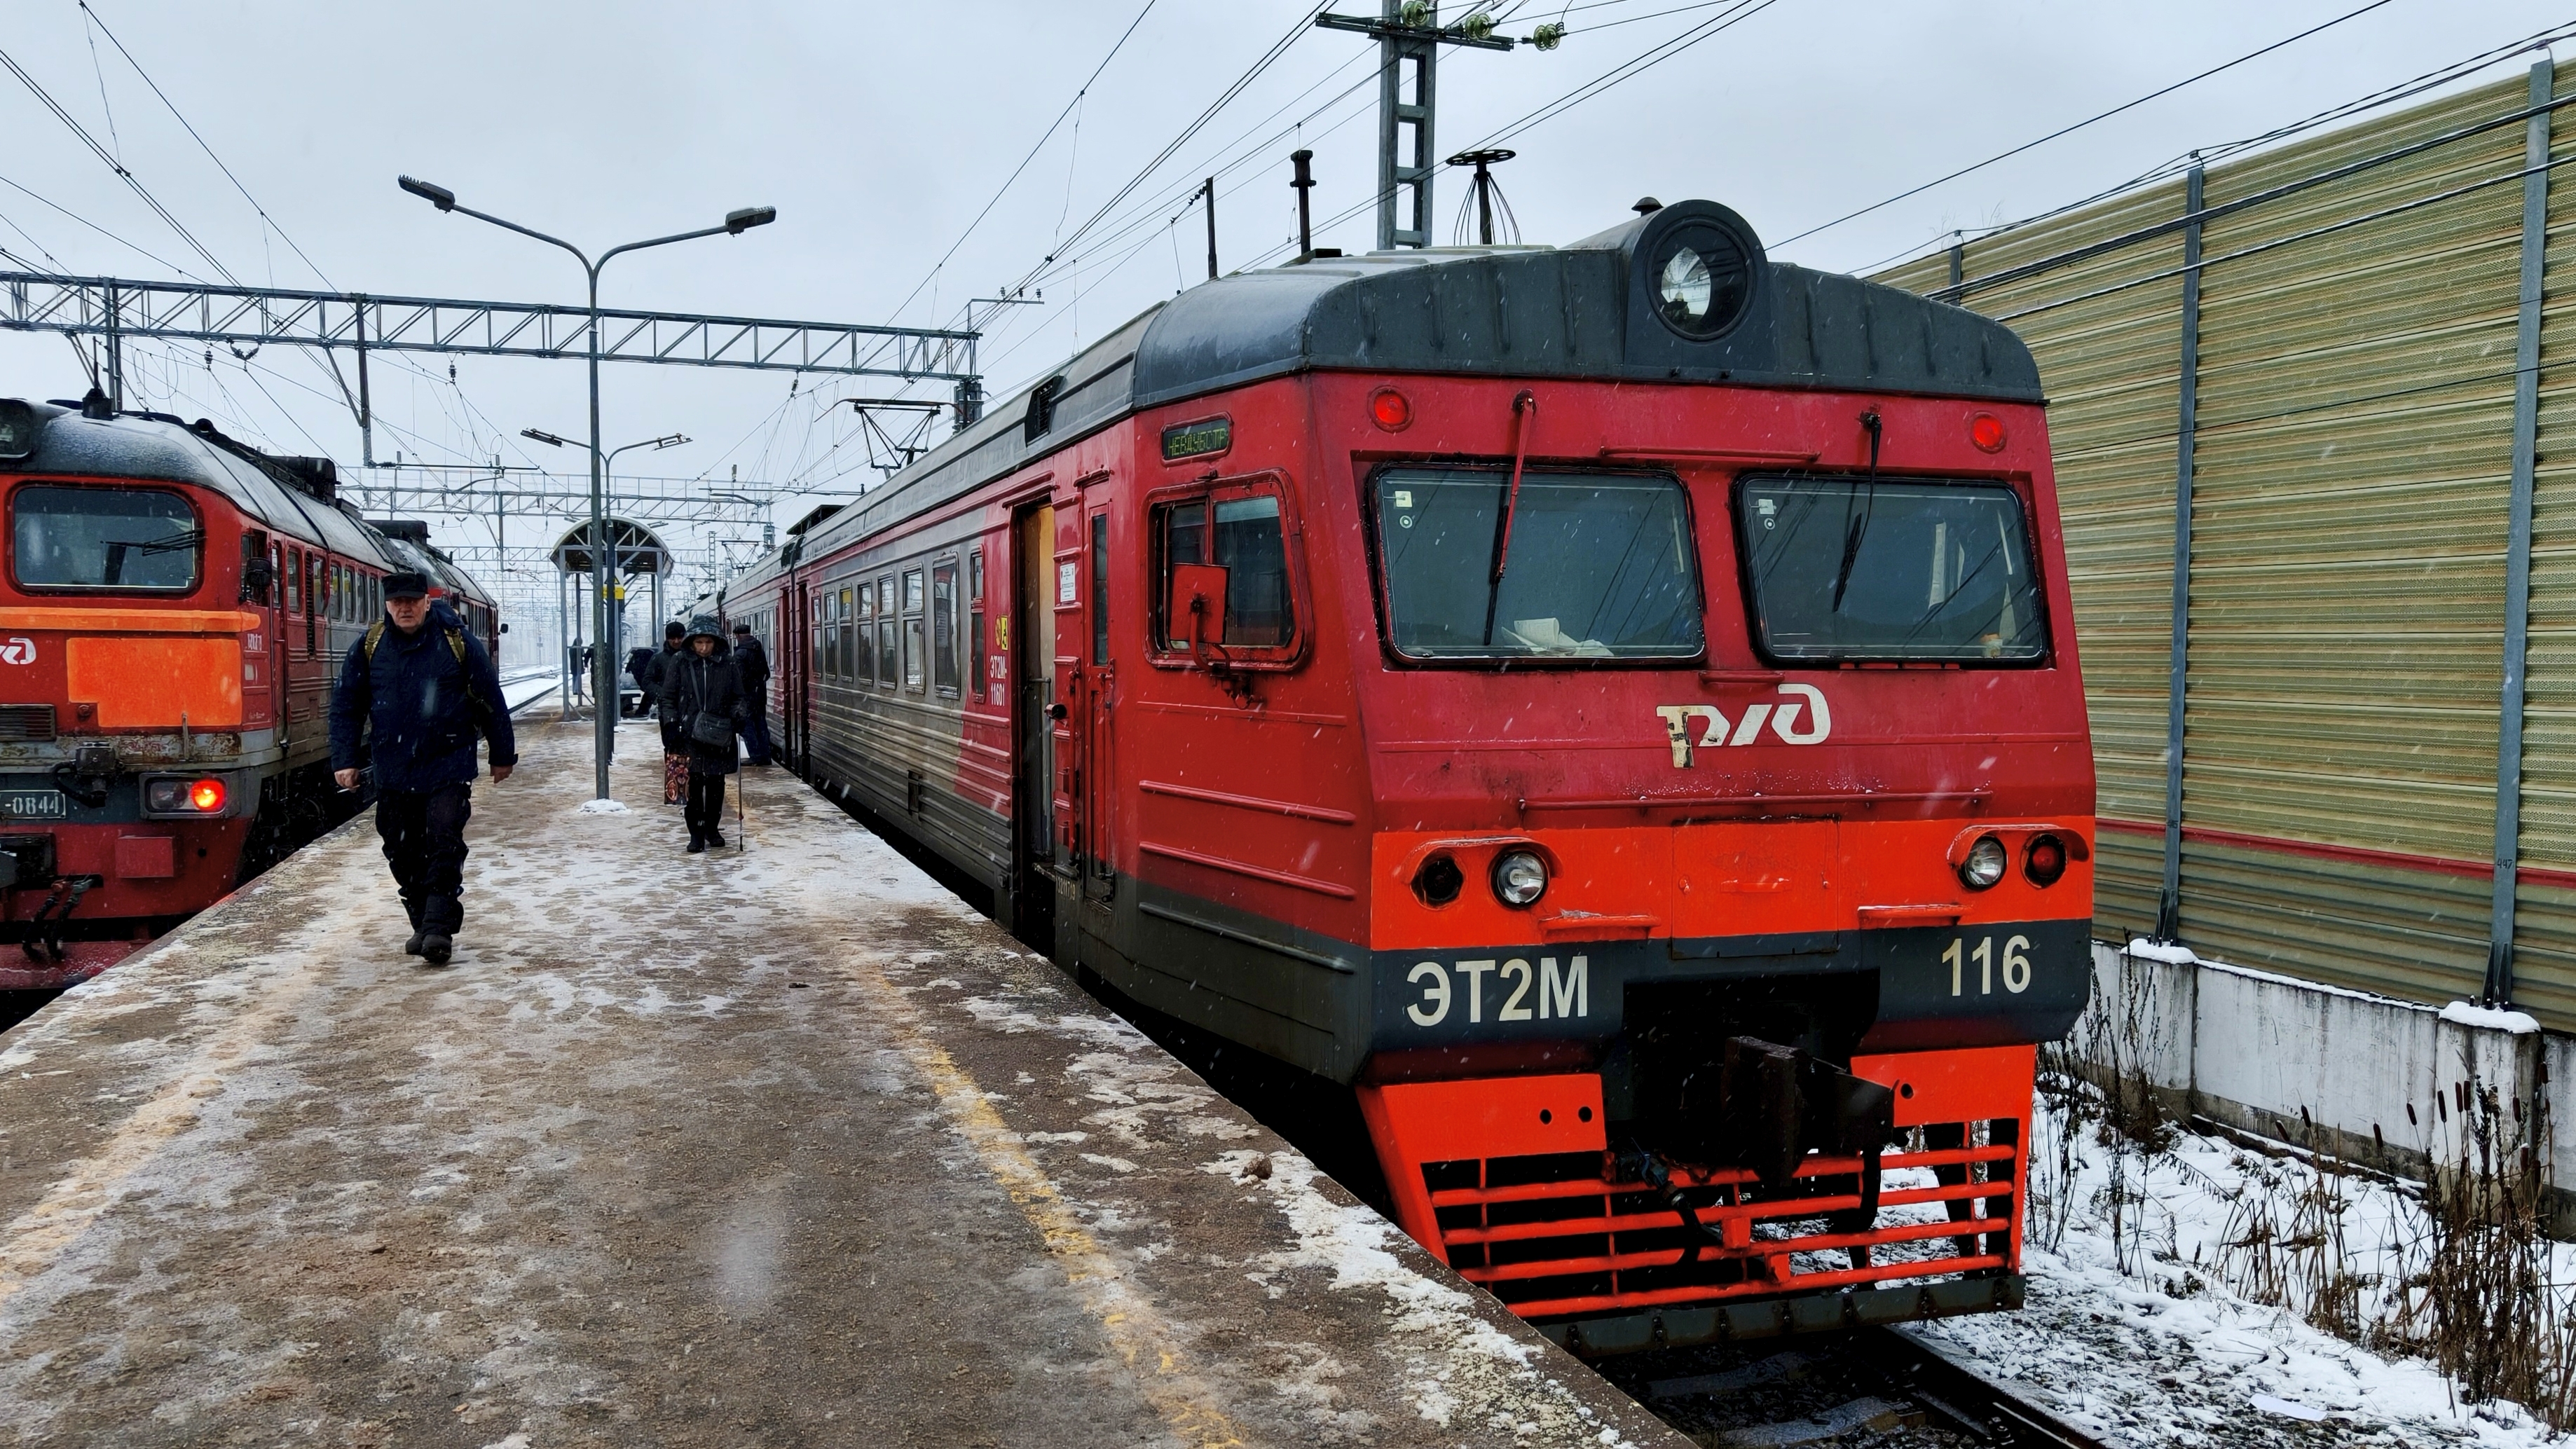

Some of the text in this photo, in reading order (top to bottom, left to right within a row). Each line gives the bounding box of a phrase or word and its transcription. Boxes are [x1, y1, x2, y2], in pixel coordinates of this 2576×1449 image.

[2497, 858, 2513, 870] 447
[1406, 955, 1588, 1026] ЭТ2М
[1942, 935, 2031, 996] 116
